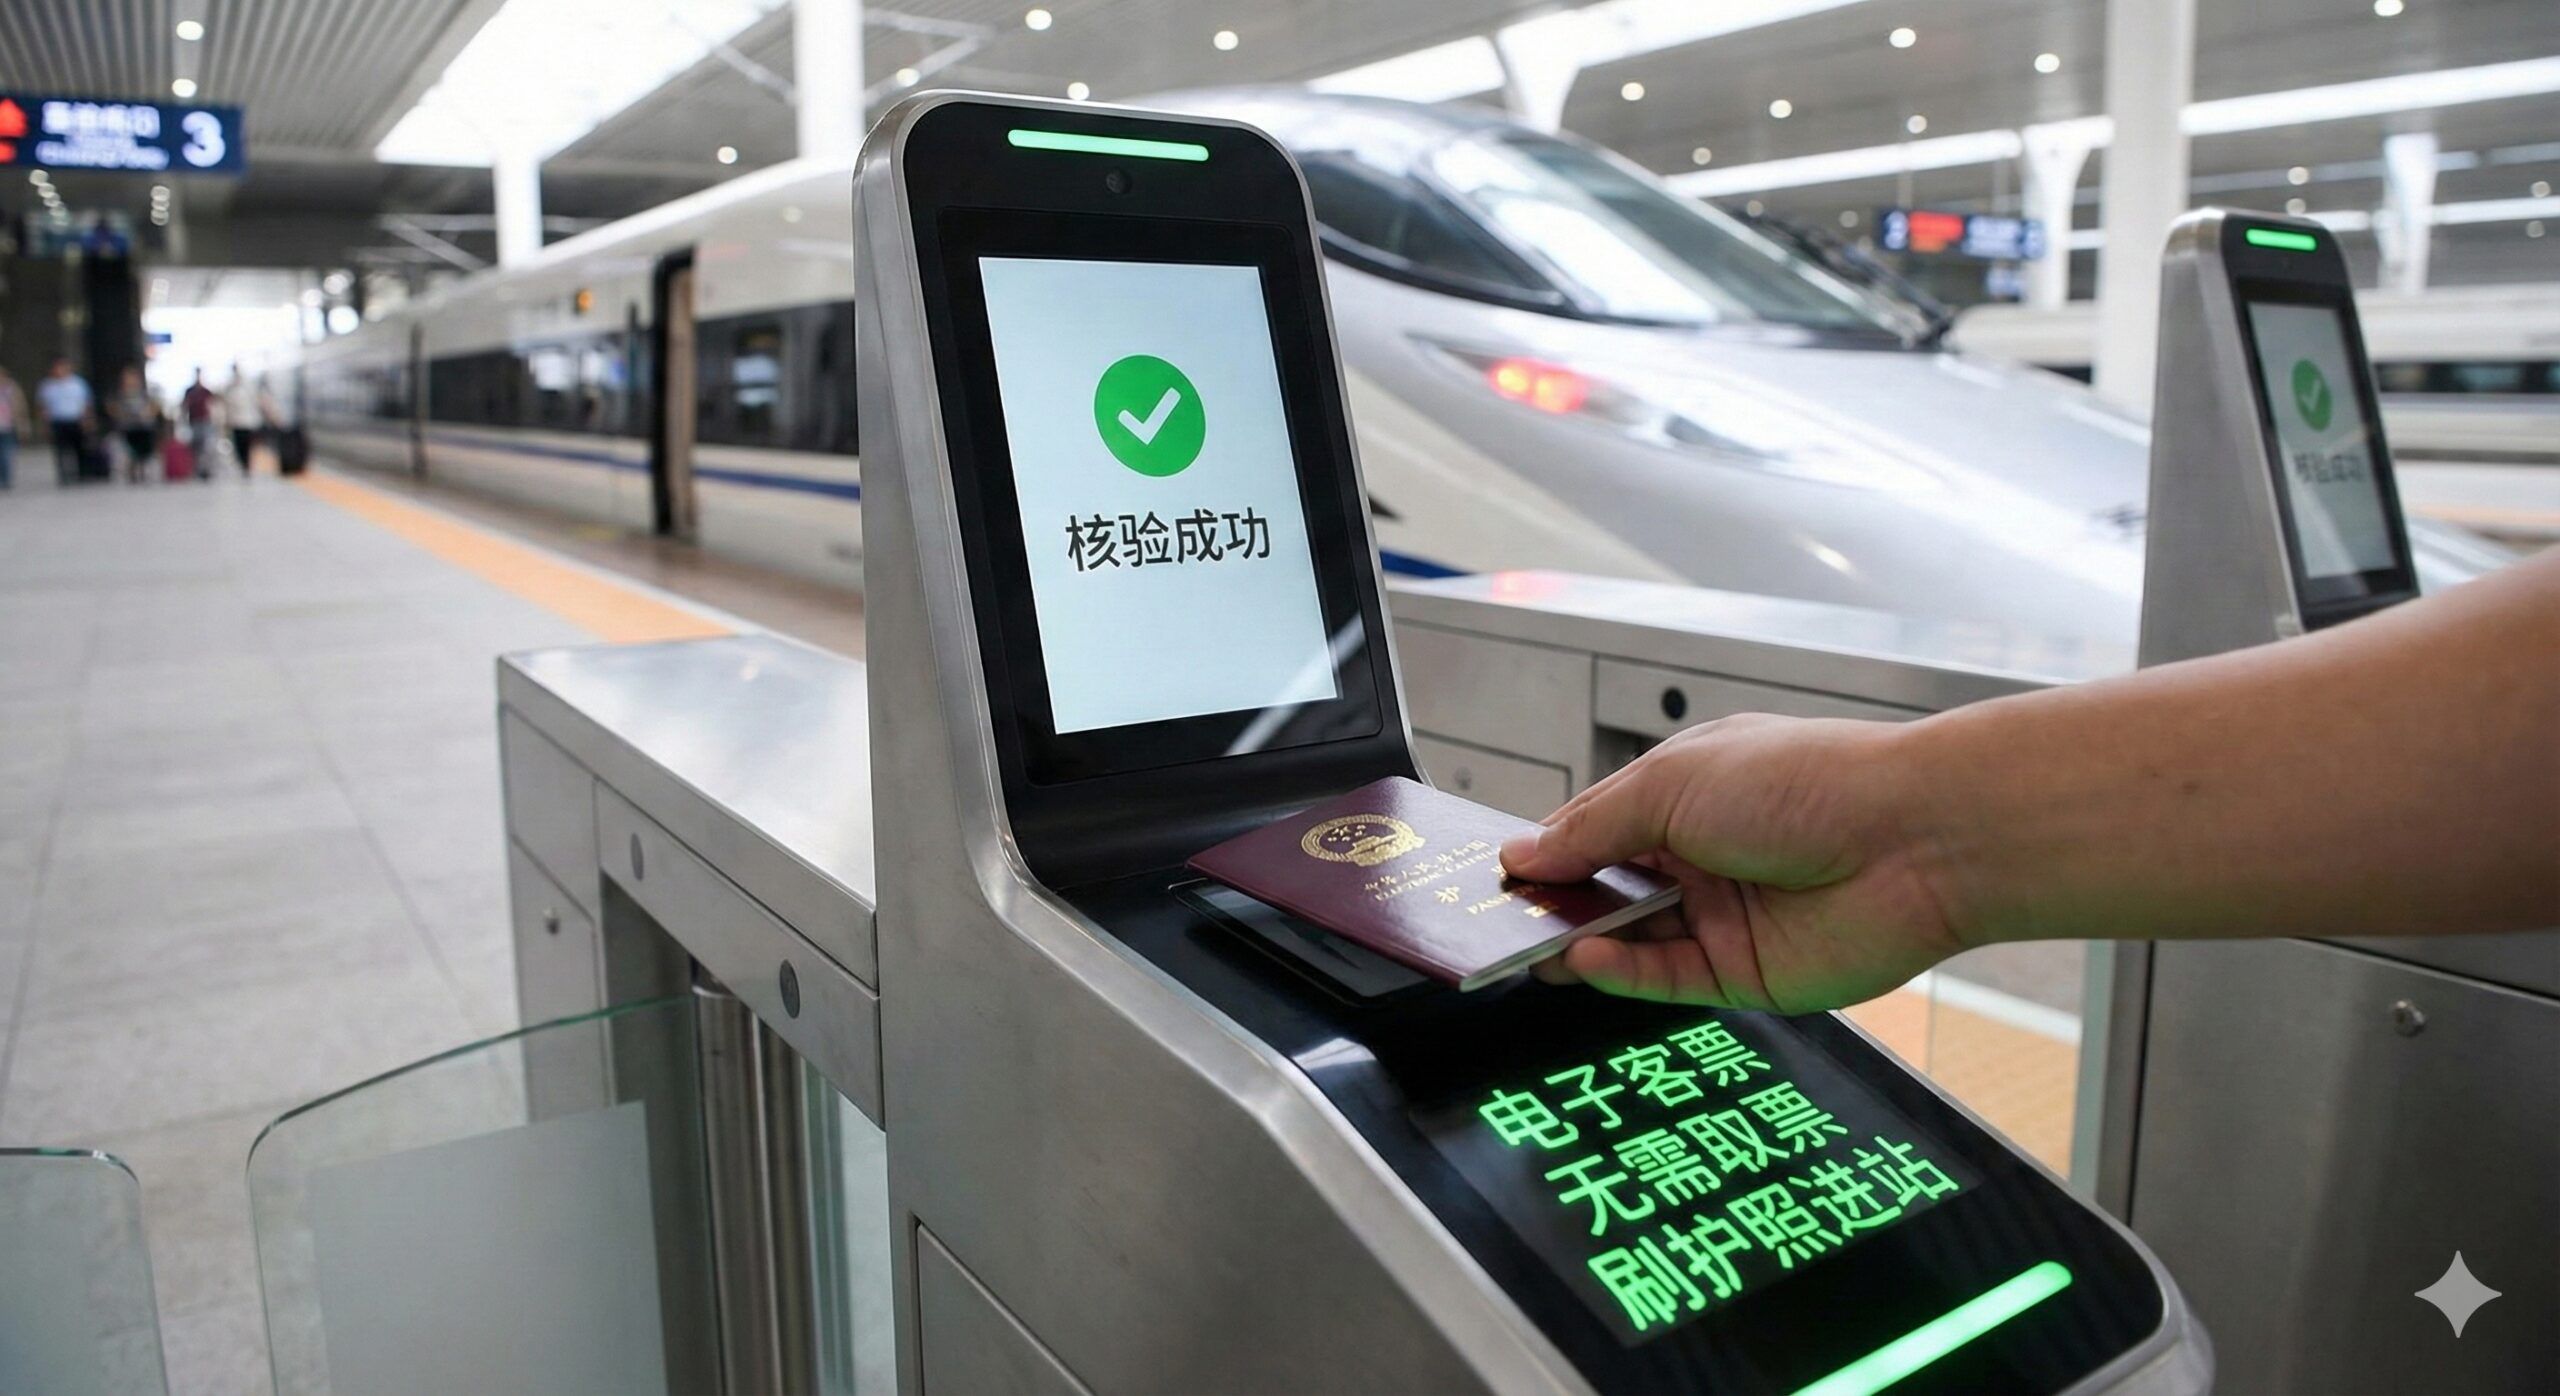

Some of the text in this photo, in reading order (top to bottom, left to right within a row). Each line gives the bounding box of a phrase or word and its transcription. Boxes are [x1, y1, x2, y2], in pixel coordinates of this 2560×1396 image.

[181, 110, 226, 168] 3
[1065, 506, 1271, 572] 核验成功
[1477, 1020, 1772, 1150] 电子客票
[1543, 1080, 1848, 1237] 无需取票
[1586, 1135, 1960, 1332] 刷护照进站
